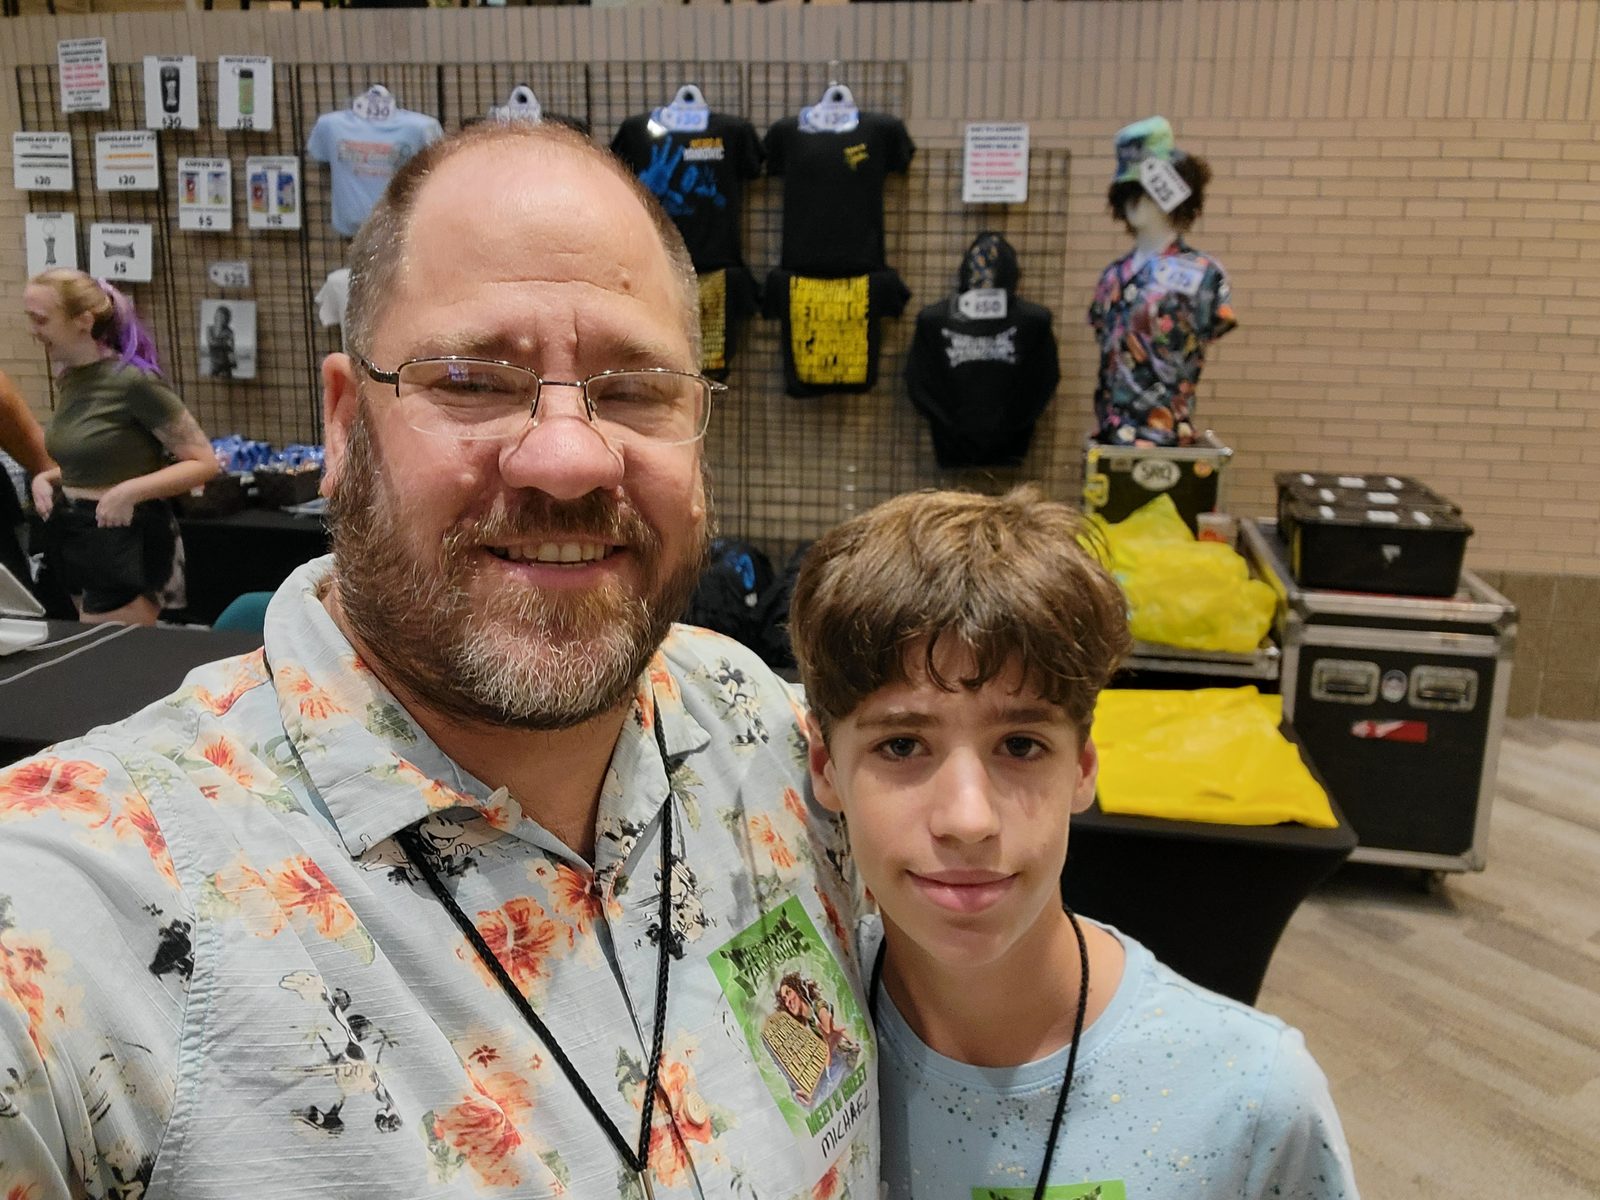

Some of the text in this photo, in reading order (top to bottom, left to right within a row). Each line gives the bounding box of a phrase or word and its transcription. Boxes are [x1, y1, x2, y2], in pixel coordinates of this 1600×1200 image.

[805, 1097, 834, 1138] MEET
[832, 1087, 843, 1112] &
[821, 1089, 870, 1158] MICHAEL
